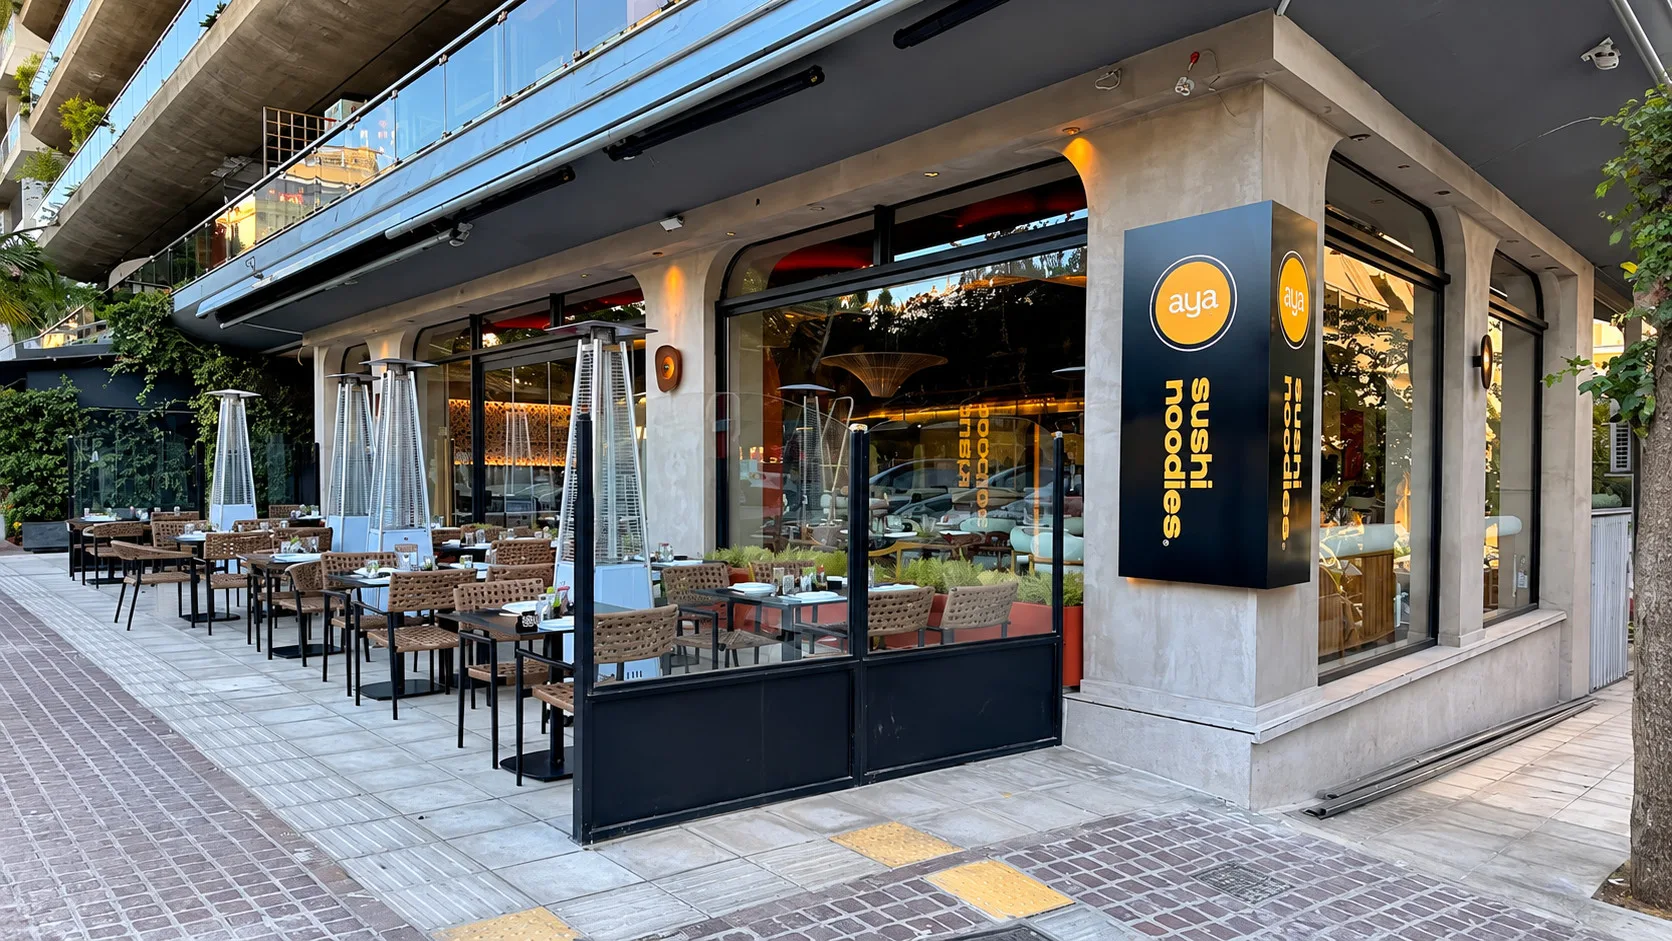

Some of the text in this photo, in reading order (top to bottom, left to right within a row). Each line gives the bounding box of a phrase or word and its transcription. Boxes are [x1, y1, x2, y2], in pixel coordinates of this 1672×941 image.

[1168, 289, 1219, 318] aya
[1283, 286, 1304, 316] aya
[1190, 376, 1213, 489] sushi
[1292, 377, 1302, 489] sushi
